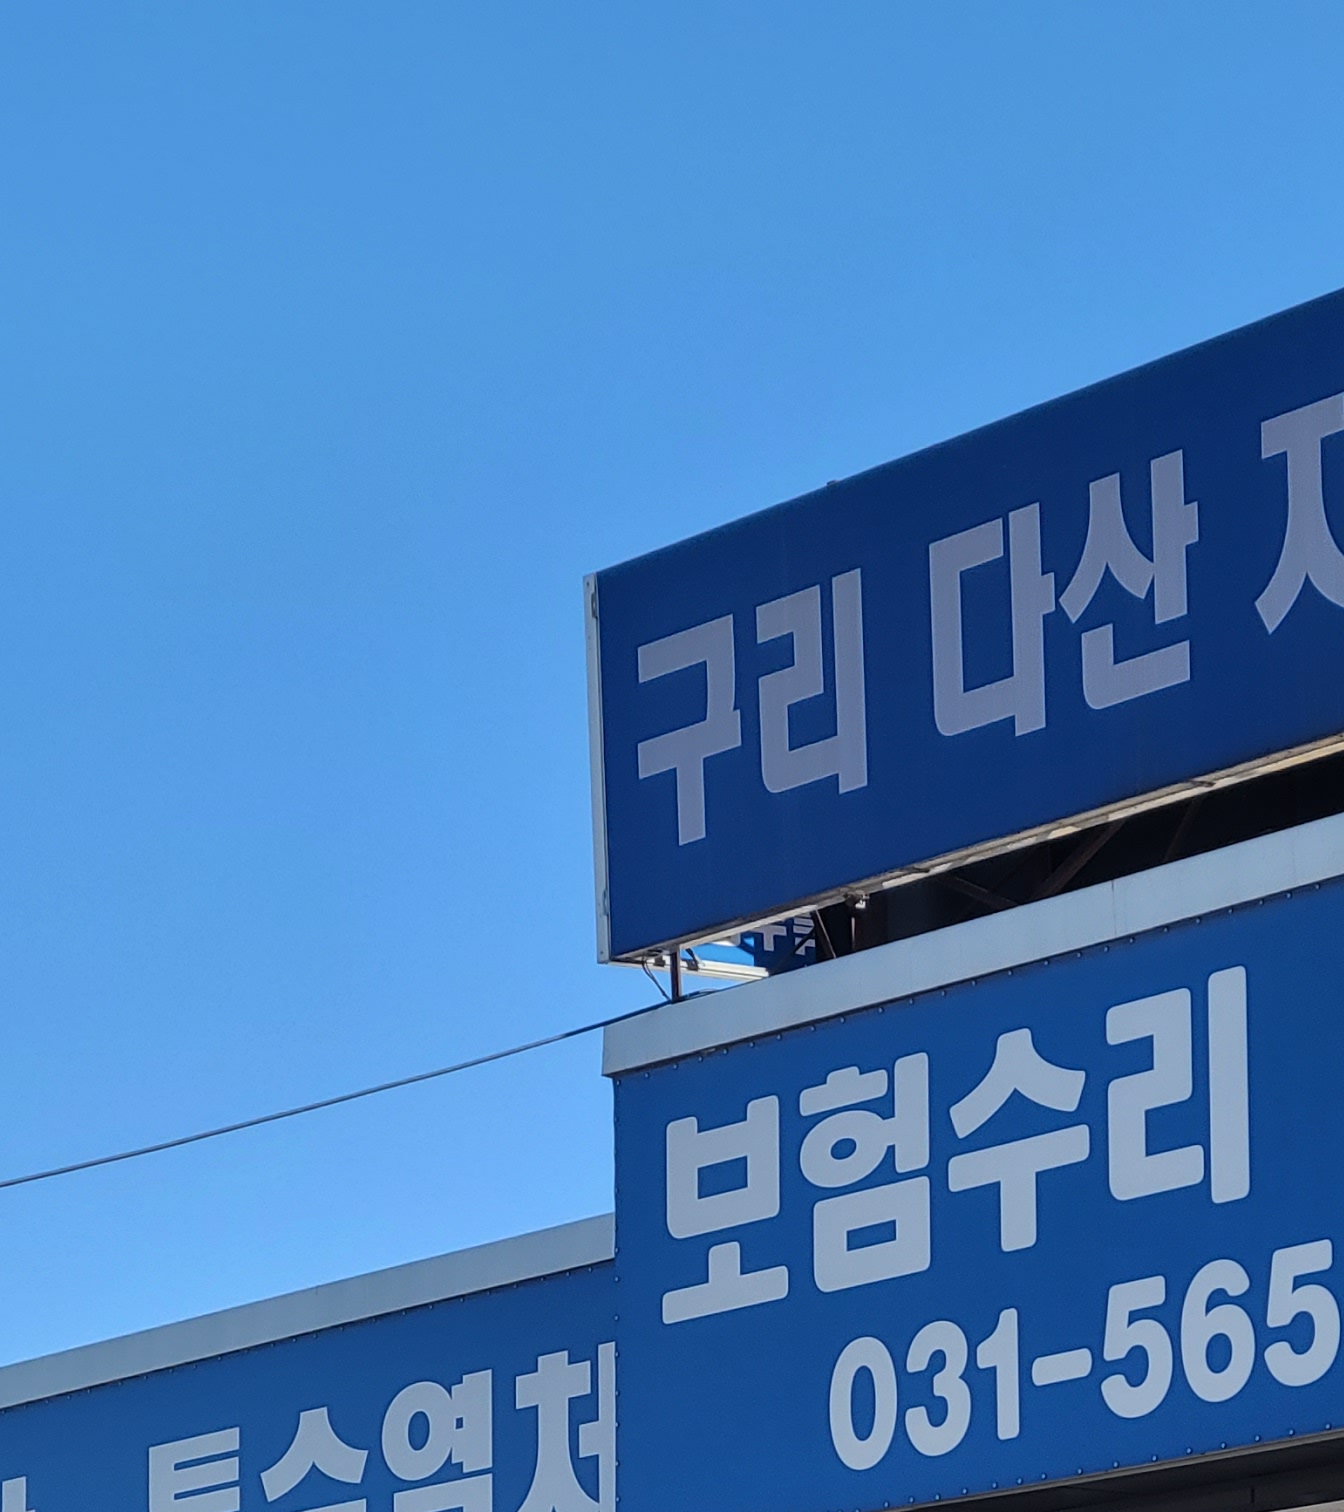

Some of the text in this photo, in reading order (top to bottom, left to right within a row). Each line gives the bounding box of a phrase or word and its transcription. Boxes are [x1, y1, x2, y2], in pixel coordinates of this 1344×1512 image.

[638, 568, 867, 845] 구리
[929, 450, 1199, 737] 다산
[662, 965, 1250, 1325] 보험수리
